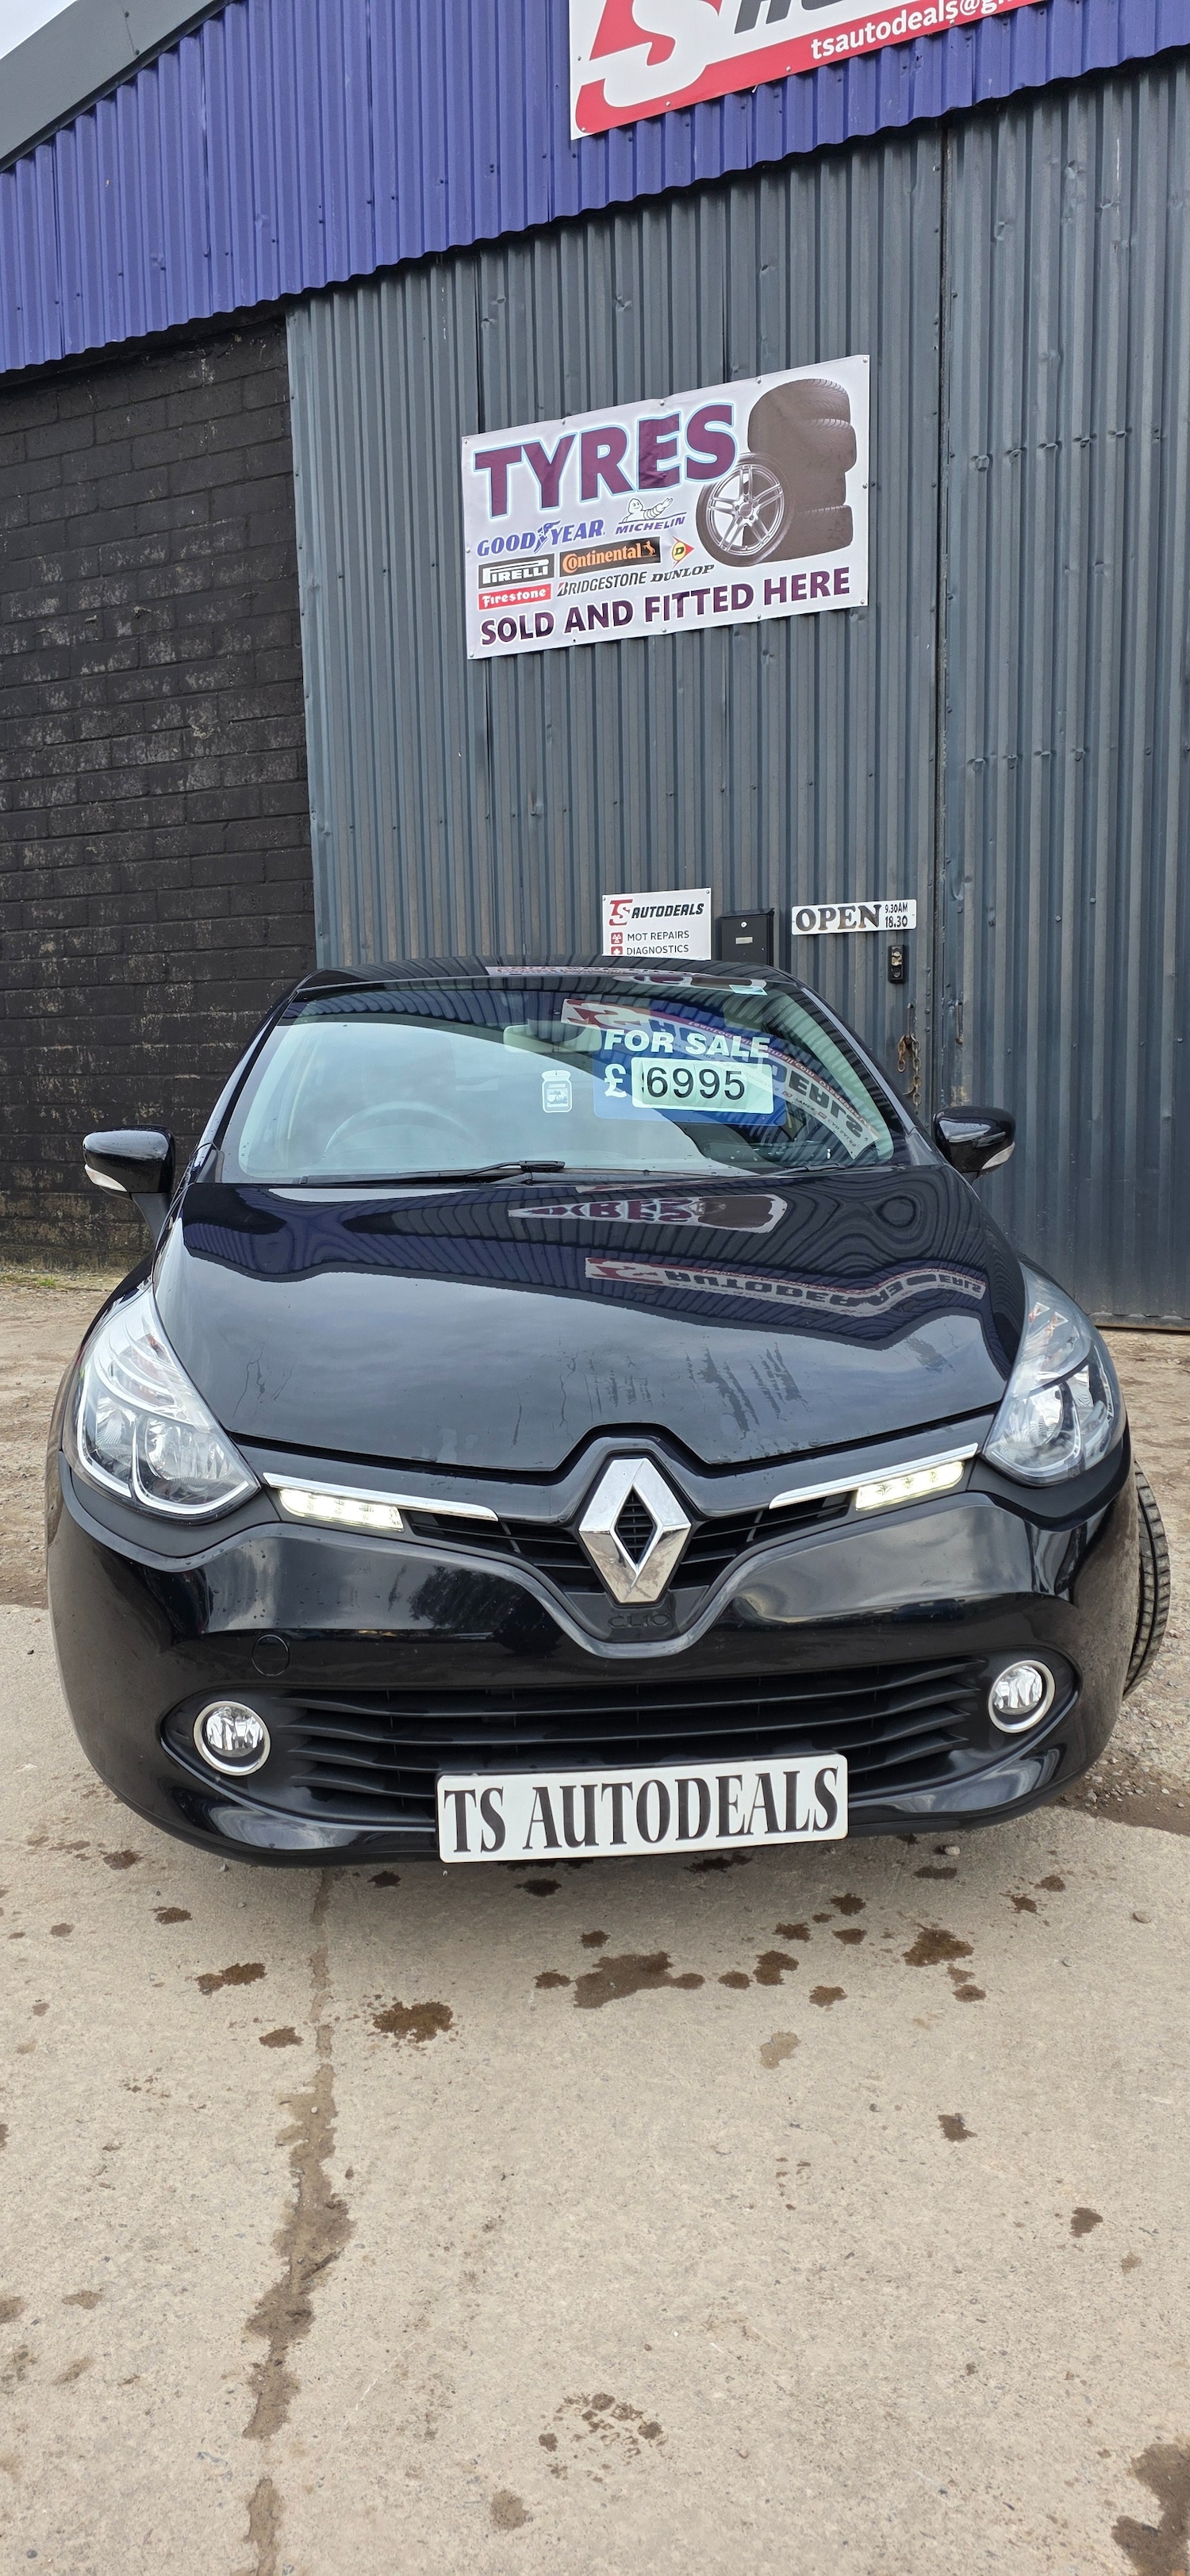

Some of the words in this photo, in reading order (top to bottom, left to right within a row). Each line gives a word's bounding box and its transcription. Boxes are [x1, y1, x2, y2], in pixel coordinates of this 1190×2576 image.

[473, 402, 738, 519] TYRES
[615, 516, 686, 535] MICHELIN
[562, 543, 642, 574] Continental
[482, 559, 550, 585] PIRELLI
[651, 564, 715, 583] DUNLOP
[557, 571, 648, 597] BRIDGESTONE
[481, 612, 554, 646] SOLD
[564, 600, 634, 634] AND
[645, 583, 754, 623] FITTED
[762, 566, 850, 606] HERE
[482, 588, 547, 608] Firestone
[631, 903, 704, 919] AUTODEALS
[796, 904, 881, 931] OPEN
[885, 902, 908, 913] 9.30AM
[885, 915, 908, 928] 18.30
[628, 933, 647, 942] MOT
[651, 931, 689, 940] REPAIRS
[627, 944, 689, 955] DIAGNOSTICS
[604, 1028, 674, 1054] FOR
[685, 1032, 770, 1058] SALE
[608, 1614, 670, 1629] CLIO
[443, 1786, 506, 1853] TS
[523, 1767, 839, 1849] AUTODEALS
